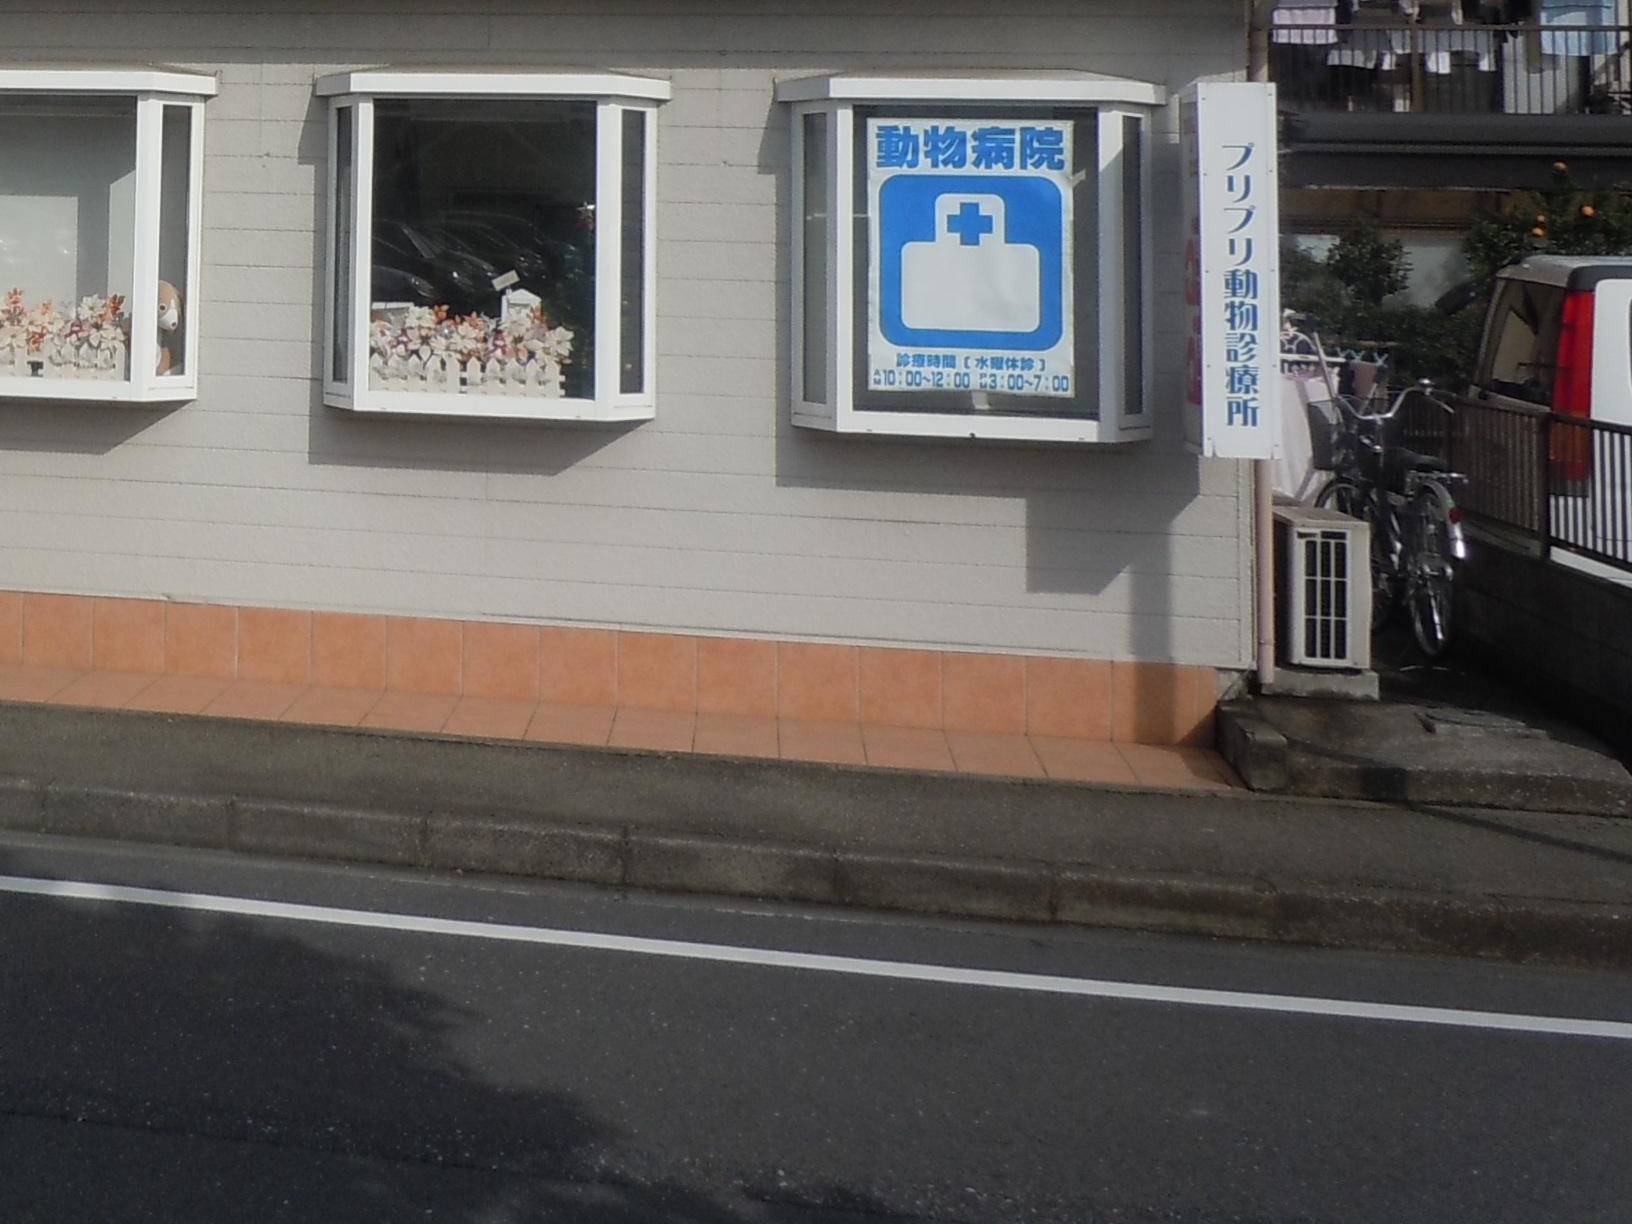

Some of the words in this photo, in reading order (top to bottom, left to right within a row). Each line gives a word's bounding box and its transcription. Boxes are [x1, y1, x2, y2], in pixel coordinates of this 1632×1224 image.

[875, 125, 1066, 171] 動物病院
[1221, 141, 1260, 428] プリプリ動物診療所
[896, 353, 957, 368] 診療時間
